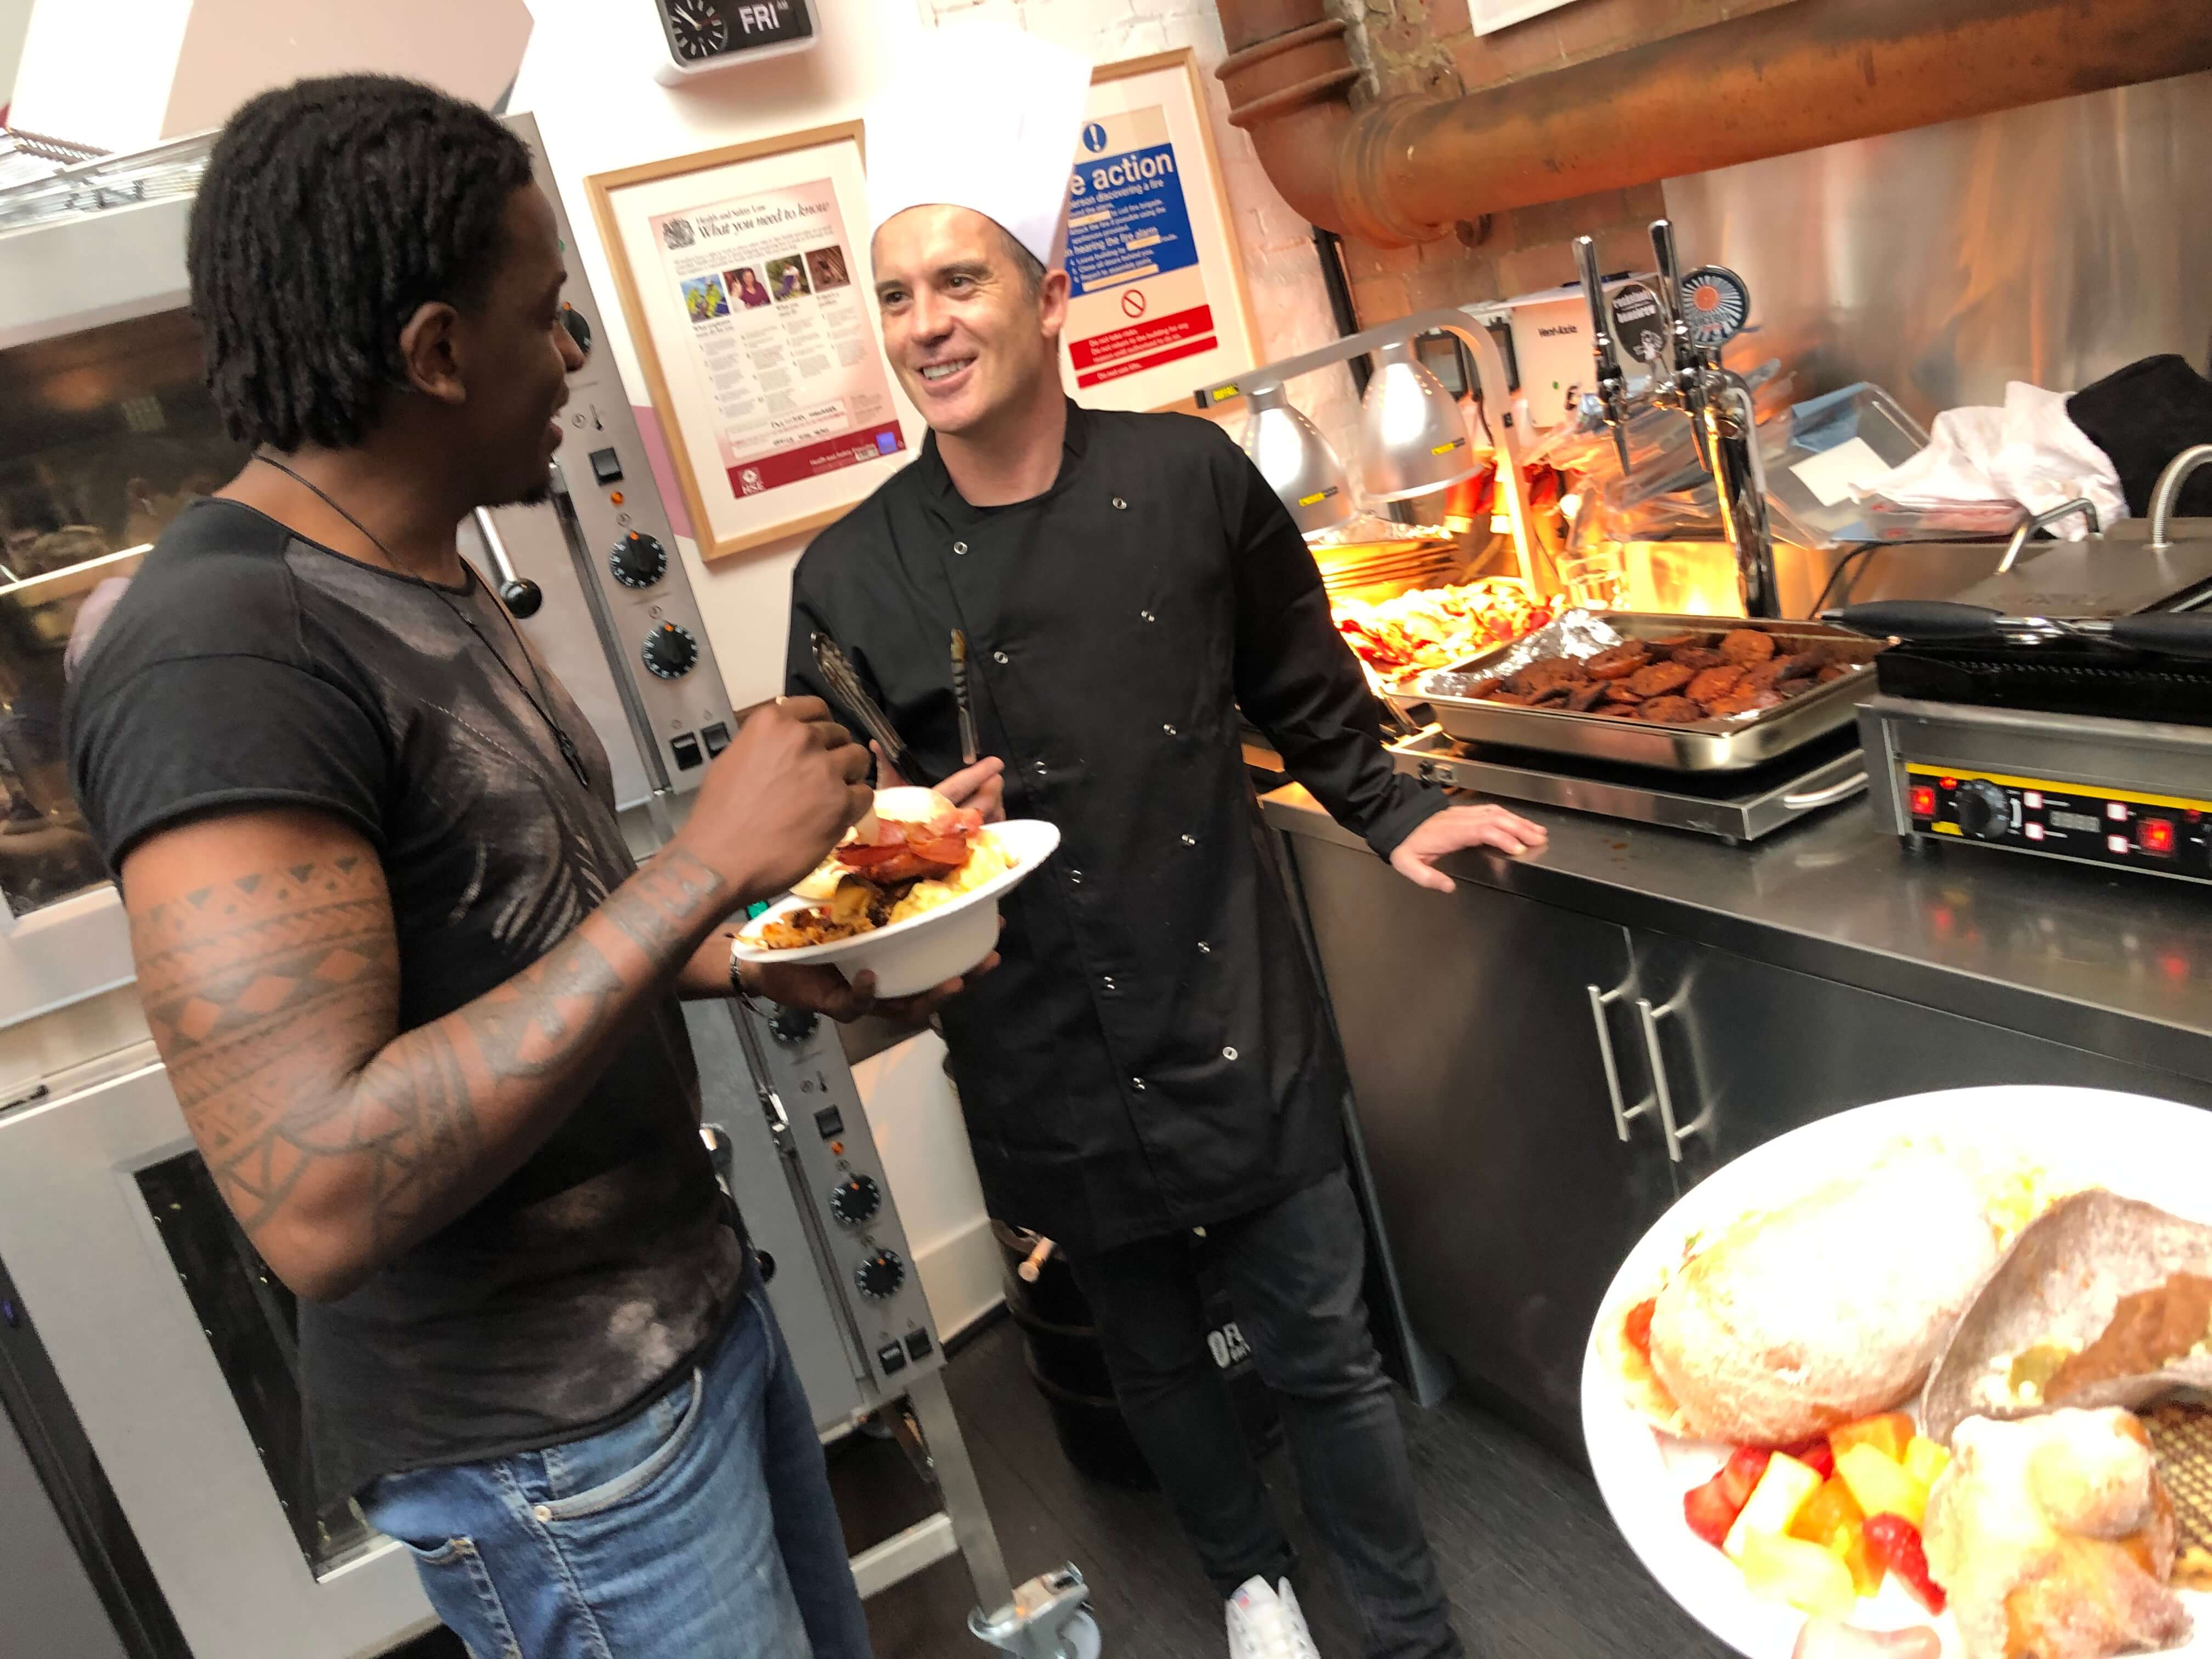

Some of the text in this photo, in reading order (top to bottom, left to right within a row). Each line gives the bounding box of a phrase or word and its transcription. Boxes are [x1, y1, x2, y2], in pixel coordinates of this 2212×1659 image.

[738, 2, 780, 34] FRI
[1092, 154, 1173, 190] action
[697, 201, 830, 239] What you need to know
